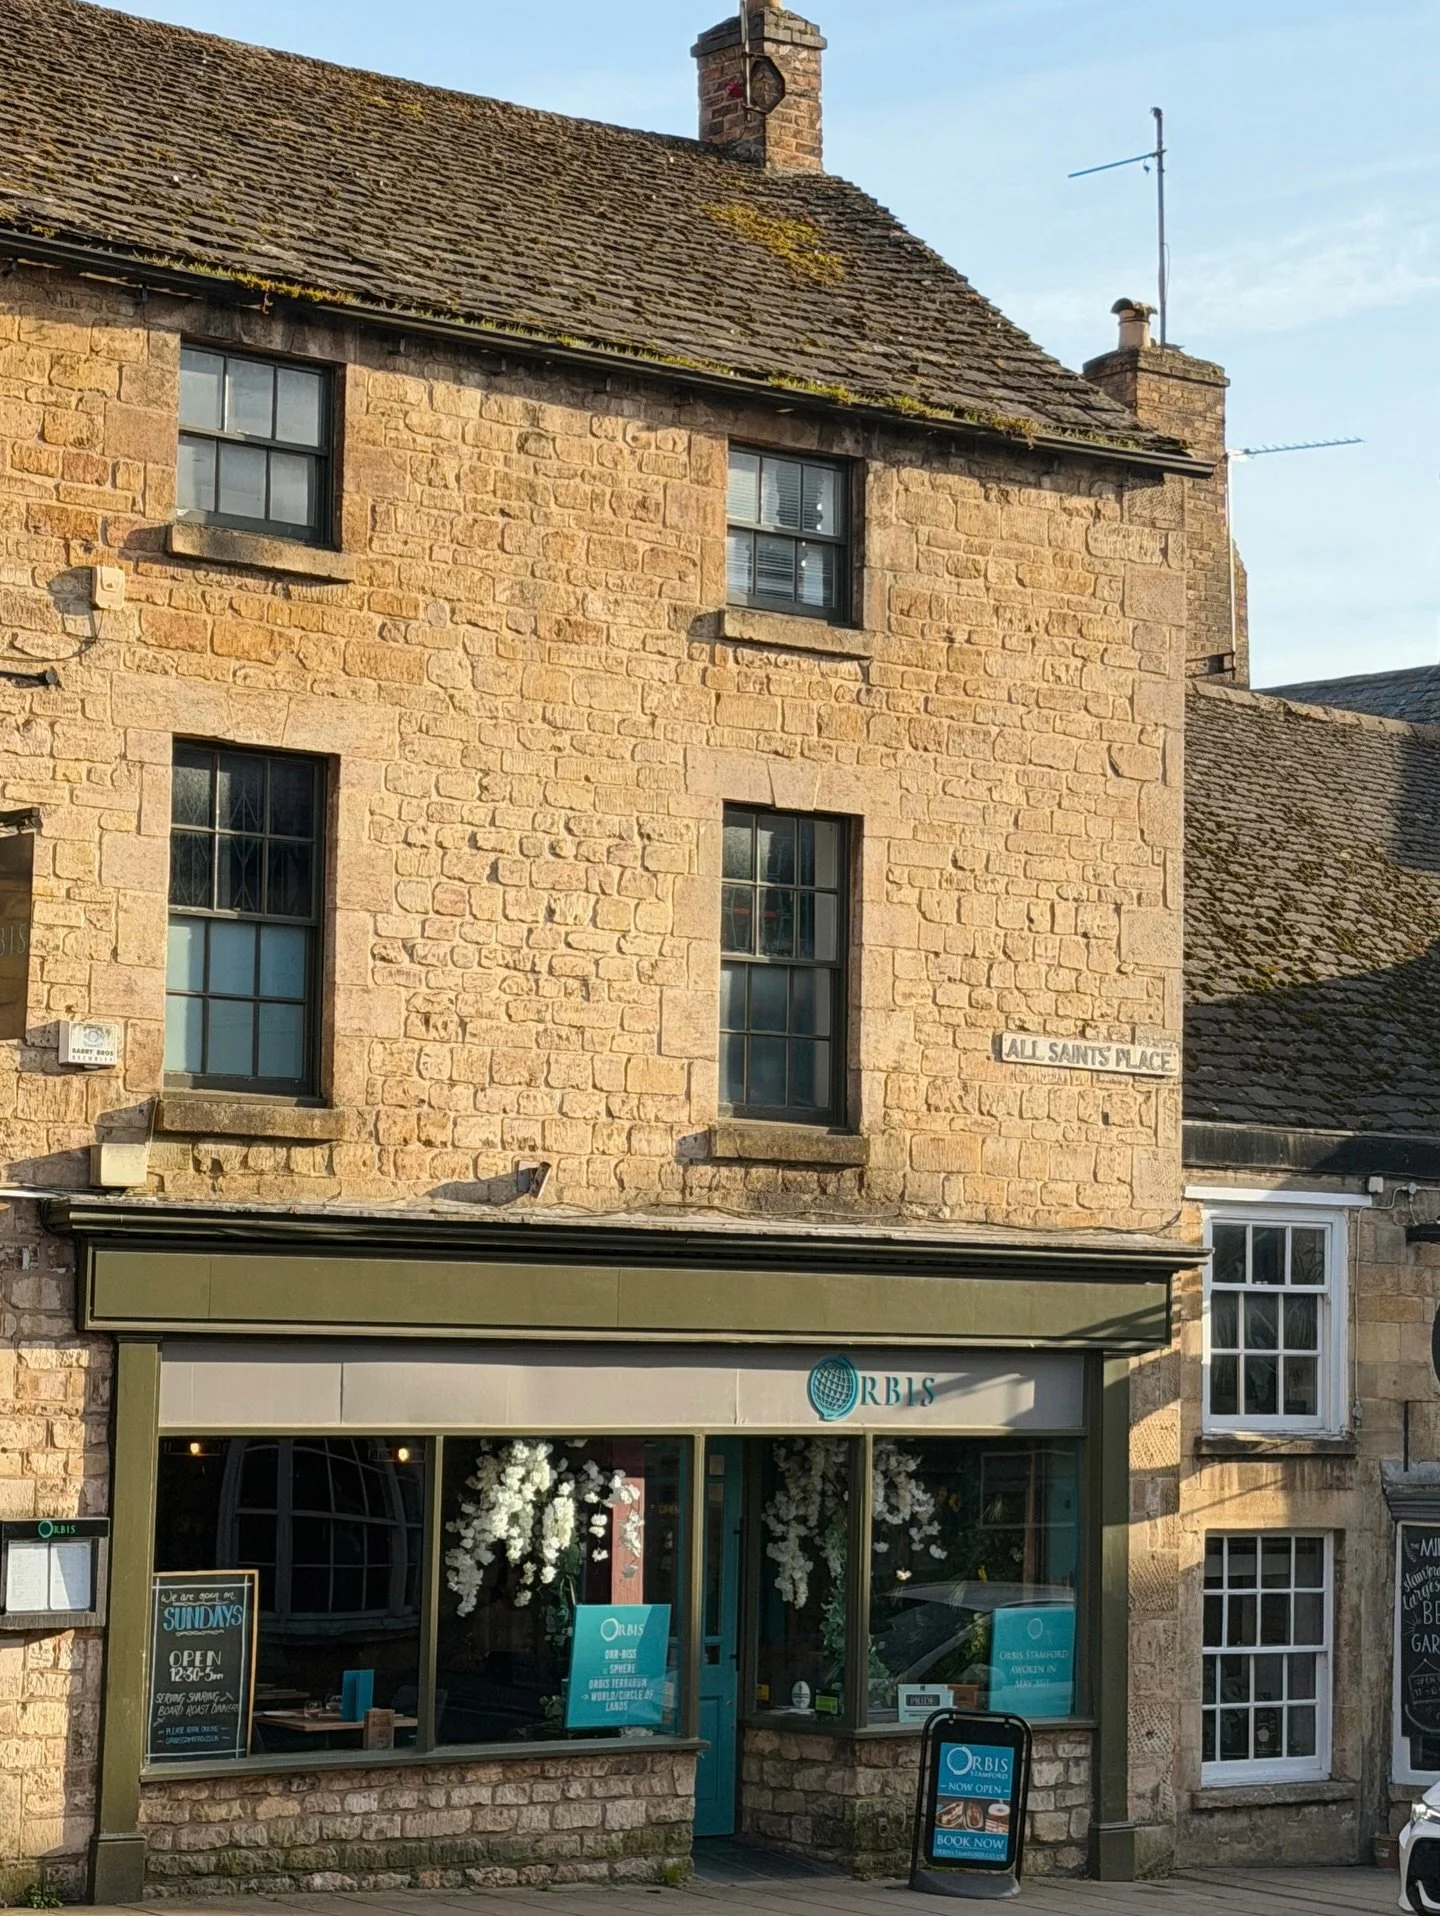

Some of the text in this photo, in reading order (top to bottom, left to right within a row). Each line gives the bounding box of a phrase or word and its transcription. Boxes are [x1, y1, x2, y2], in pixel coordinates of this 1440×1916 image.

[1006, 1039, 1045, 1061] ALL
[1115, 1047, 1176, 1073] PLACE
[807, 1354, 936, 1422] ORBIS
[38, 1520, 76, 1538] ORBIS
[161, 1590, 177, 1603] We
[180, 1593, 194, 1601] are
[199, 1592, 219, 1602] open
[163, 1605, 242, 1631] SUNDAYS
[601, 1617, 644, 1642] ORBIS
[169, 1650, 221, 1667] OPEN
[609, 1664, 636, 1674] SPHERE
[605, 1701, 628, 1712] LANDS
[947, 1746, 1008, 1775] ORBIS
[970, 1770, 1008, 1780] STAMFORD
[948, 1782, 1002, 1794] NOW OPEN
[937, 1834, 1004, 1849] BOOK NOW
